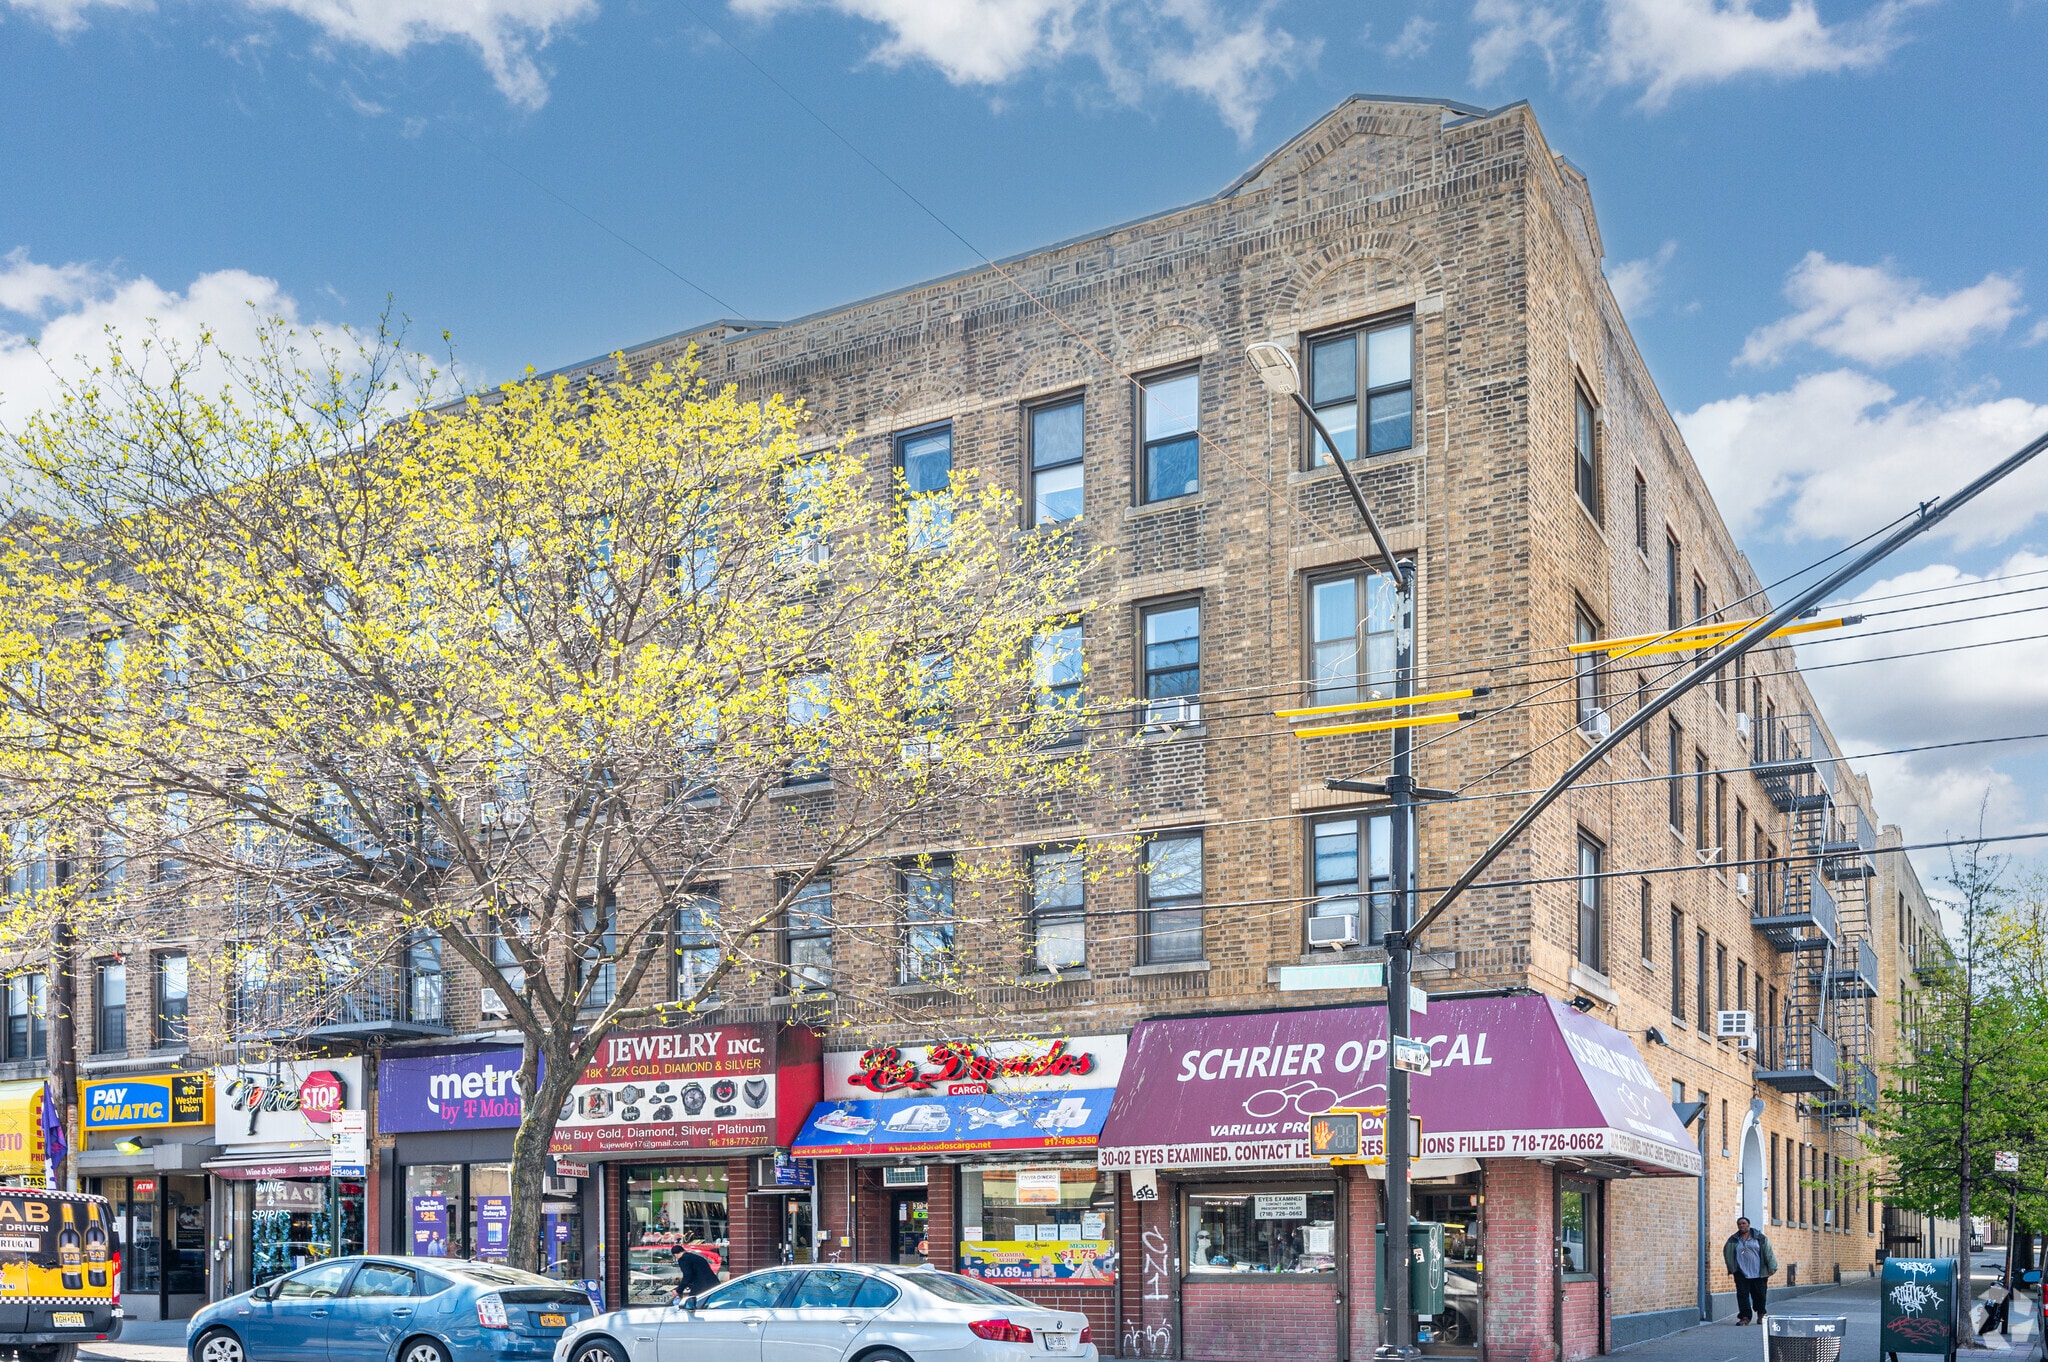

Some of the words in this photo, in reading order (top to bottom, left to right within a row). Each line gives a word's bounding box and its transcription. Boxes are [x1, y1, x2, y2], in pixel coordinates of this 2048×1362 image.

[607, 1032, 722, 1067] JEWELRY
[728, 1038, 765, 1055] INC.
[1176, 1043, 1326, 1082] SCHRIER
[1334, 1033, 1493, 1073] OPCAL
[1400, 1047, 1410, 1061] ONE
[1415, 1053, 1425, 1065] WAY
[586, 1068, 602, 1078] 18K
[611, 1066, 628, 1077] 22K
[631, 1064, 661, 1076] GOLD,
[664, 1061, 712, 1073] DIAMOND
[715, 1061, 722, 1071] &
[725, 1058, 761, 1070] SILVER
[951, 1085, 985, 1095] CARGO
[93, 1088, 127, 1105] PAY
[175, 1096, 204, 1105] Western
[303, 1086, 338, 1109] STOP
[91, 1102, 163, 1122] OMATIC
[180, 1104, 199, 1113] Union
[441, 1102, 460, 1124] by
[480, 1098, 522, 1118] Mobi
[554, 1130, 571, 1140] We
[574, 1129, 593, 1142] Buy
[596, 1127, 624, 1139] Gold,
[627, 1126, 678, 1139] Diamond,
[681, 1124, 714, 1136] Silver,
[717, 1123, 765, 1134] Platinum
[1210, 1122, 1279, 1137] VARILUX
[551, 1144, 572, 1152] 30-04
[708, 1138, 720, 1146] Tel:
[721, 1136, 768, 1146] 718-777-2777
[1044, 1136, 1097, 1146] 917-768-3350
[1101, 1150, 1131, 1166] 30-02
[1135, 1148, 1164, 1165] EYES
[1167, 1146, 1231, 1164] EXAMINED.
[1235, 1143, 1292, 1161] CONTACT
[1459, 1135, 1505, 1153] FILLED
[1512, 1132, 1604, 1152] 718-726-0662
[245, 1167, 261, 1176] Wine
[261, 1167, 267, 1175] &
[267, 1167, 286, 1176] Spirits
[256, 1182, 284, 1193] WINE
[267, 1196, 275, 1206] &
[420, 1211, 436, 1221] $25
[6, 1224, 49, 1232] DRIVEN
[0, 1239, 35, 1248] RTUGAL
[63, 1253, 80, 1261] CAB
[89, 1250, 105, 1258] CAB
[1060, 1249, 1097, 1259] $1.75
[984, 1266, 1022, 1278] $0.69
[1814, 1324, 1836, 1332] NYC
